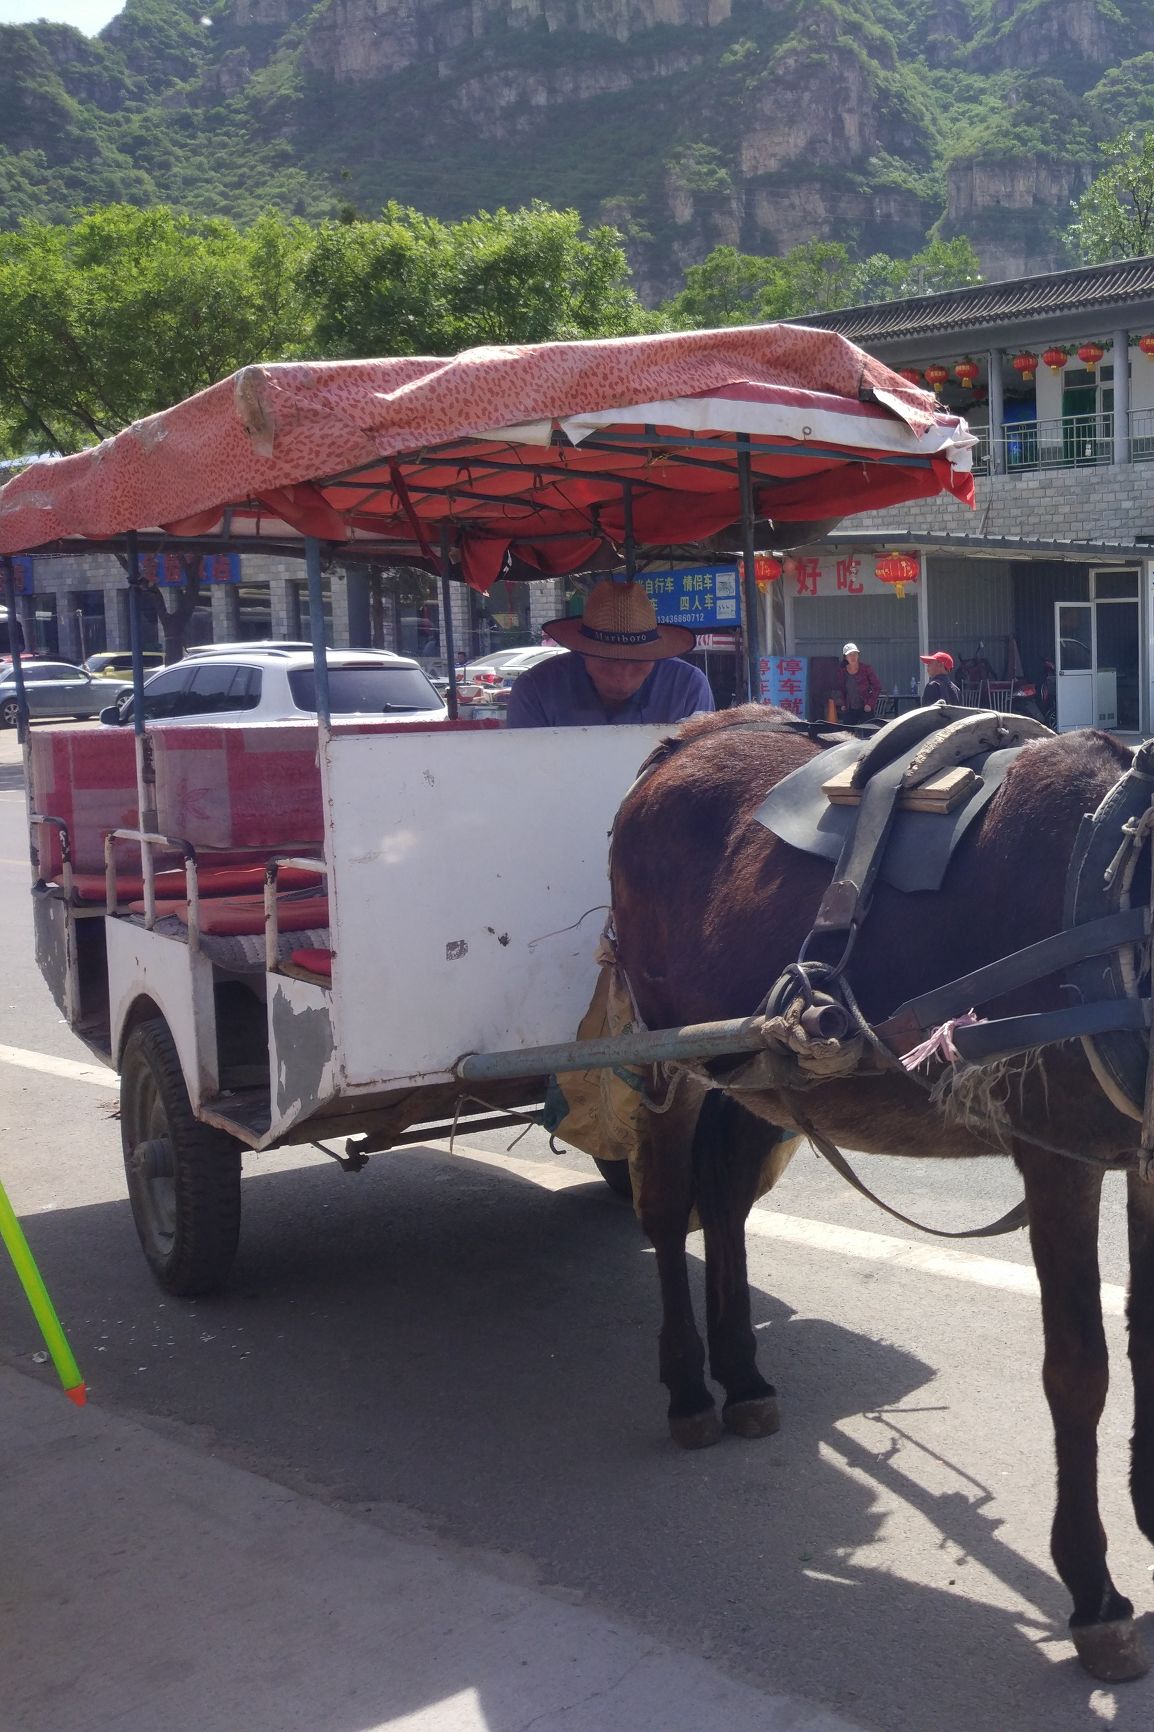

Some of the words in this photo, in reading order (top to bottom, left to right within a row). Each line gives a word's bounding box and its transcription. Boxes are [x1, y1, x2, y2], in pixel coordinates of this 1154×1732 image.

[638, 577, 674, 594] 自行车
[680, 593, 714, 611] 四人车
[593, 631, 647, 643] Marlboro
